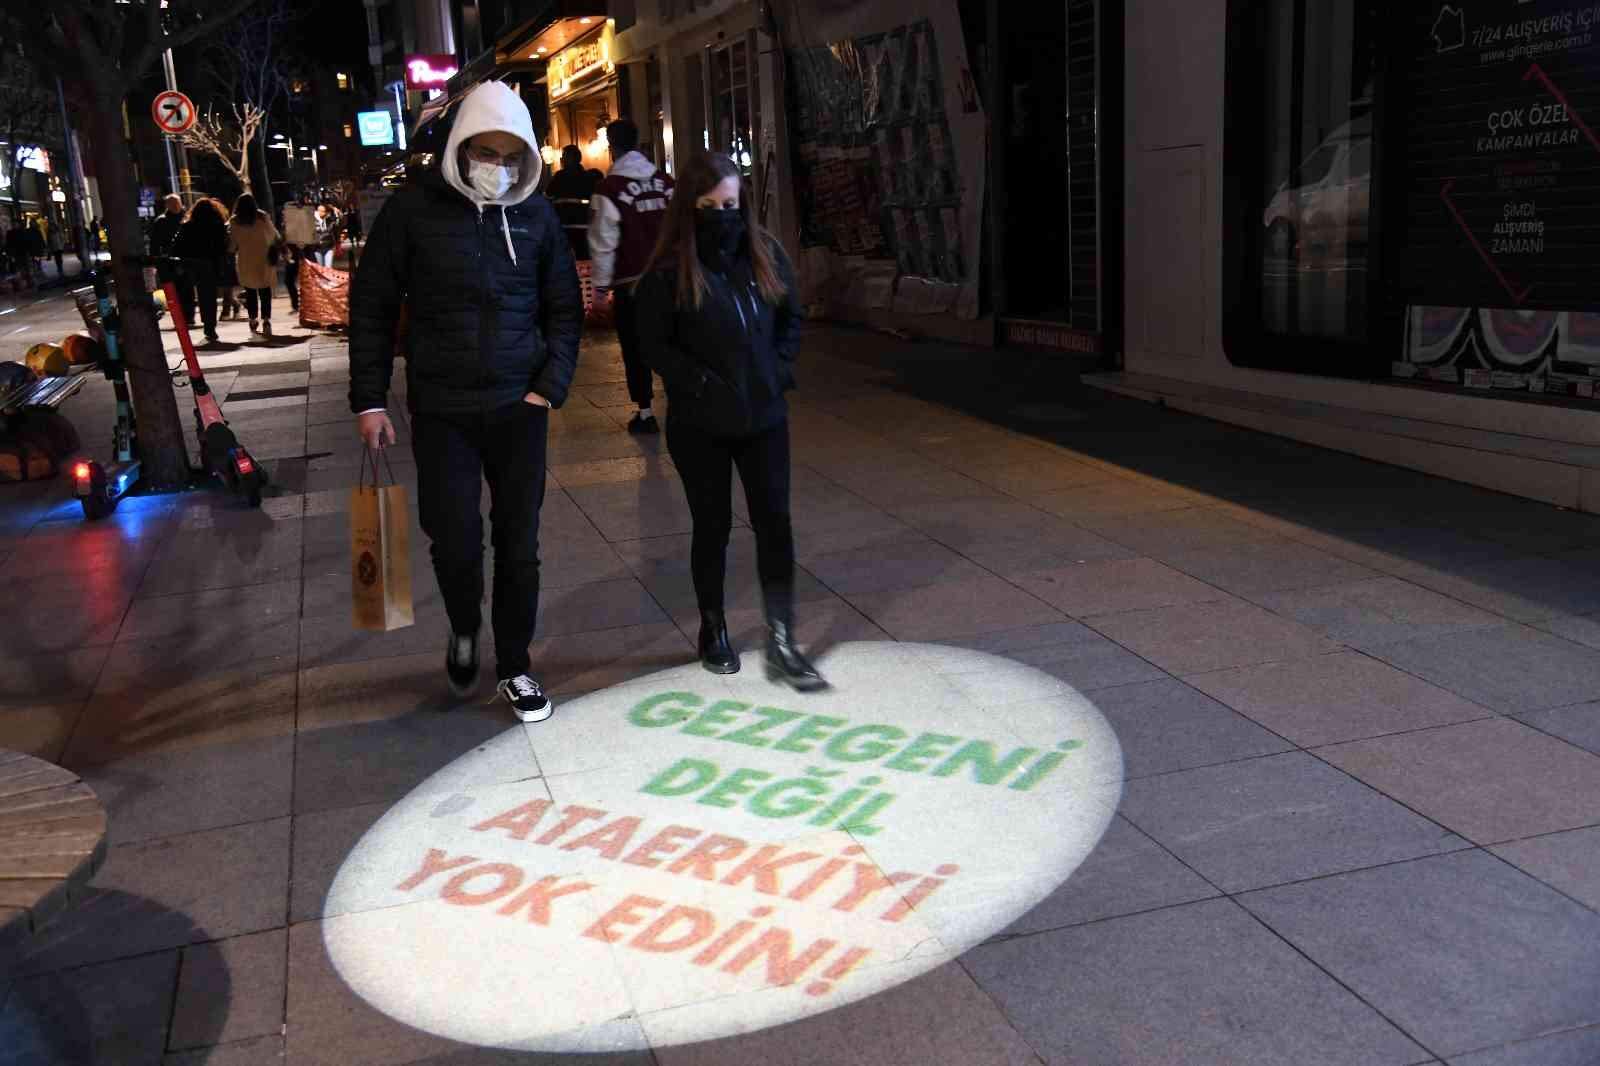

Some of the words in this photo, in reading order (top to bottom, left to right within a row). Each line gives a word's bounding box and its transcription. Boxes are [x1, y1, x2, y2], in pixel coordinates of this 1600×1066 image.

[1475, 128, 1579, 153] KAMPANYALAR
[1487, 108, 1523, 136] ÇOK
[1528, 101, 1570, 126] ÖZEL
[628, 690, 1083, 791] GEZEGENİ
[639, 757, 896, 838] DEĞİL
[471, 797, 961, 924] ATAERKİYİ
[394, 847, 593, 926] YOK
[582, 893, 871, 998] EDİN!
